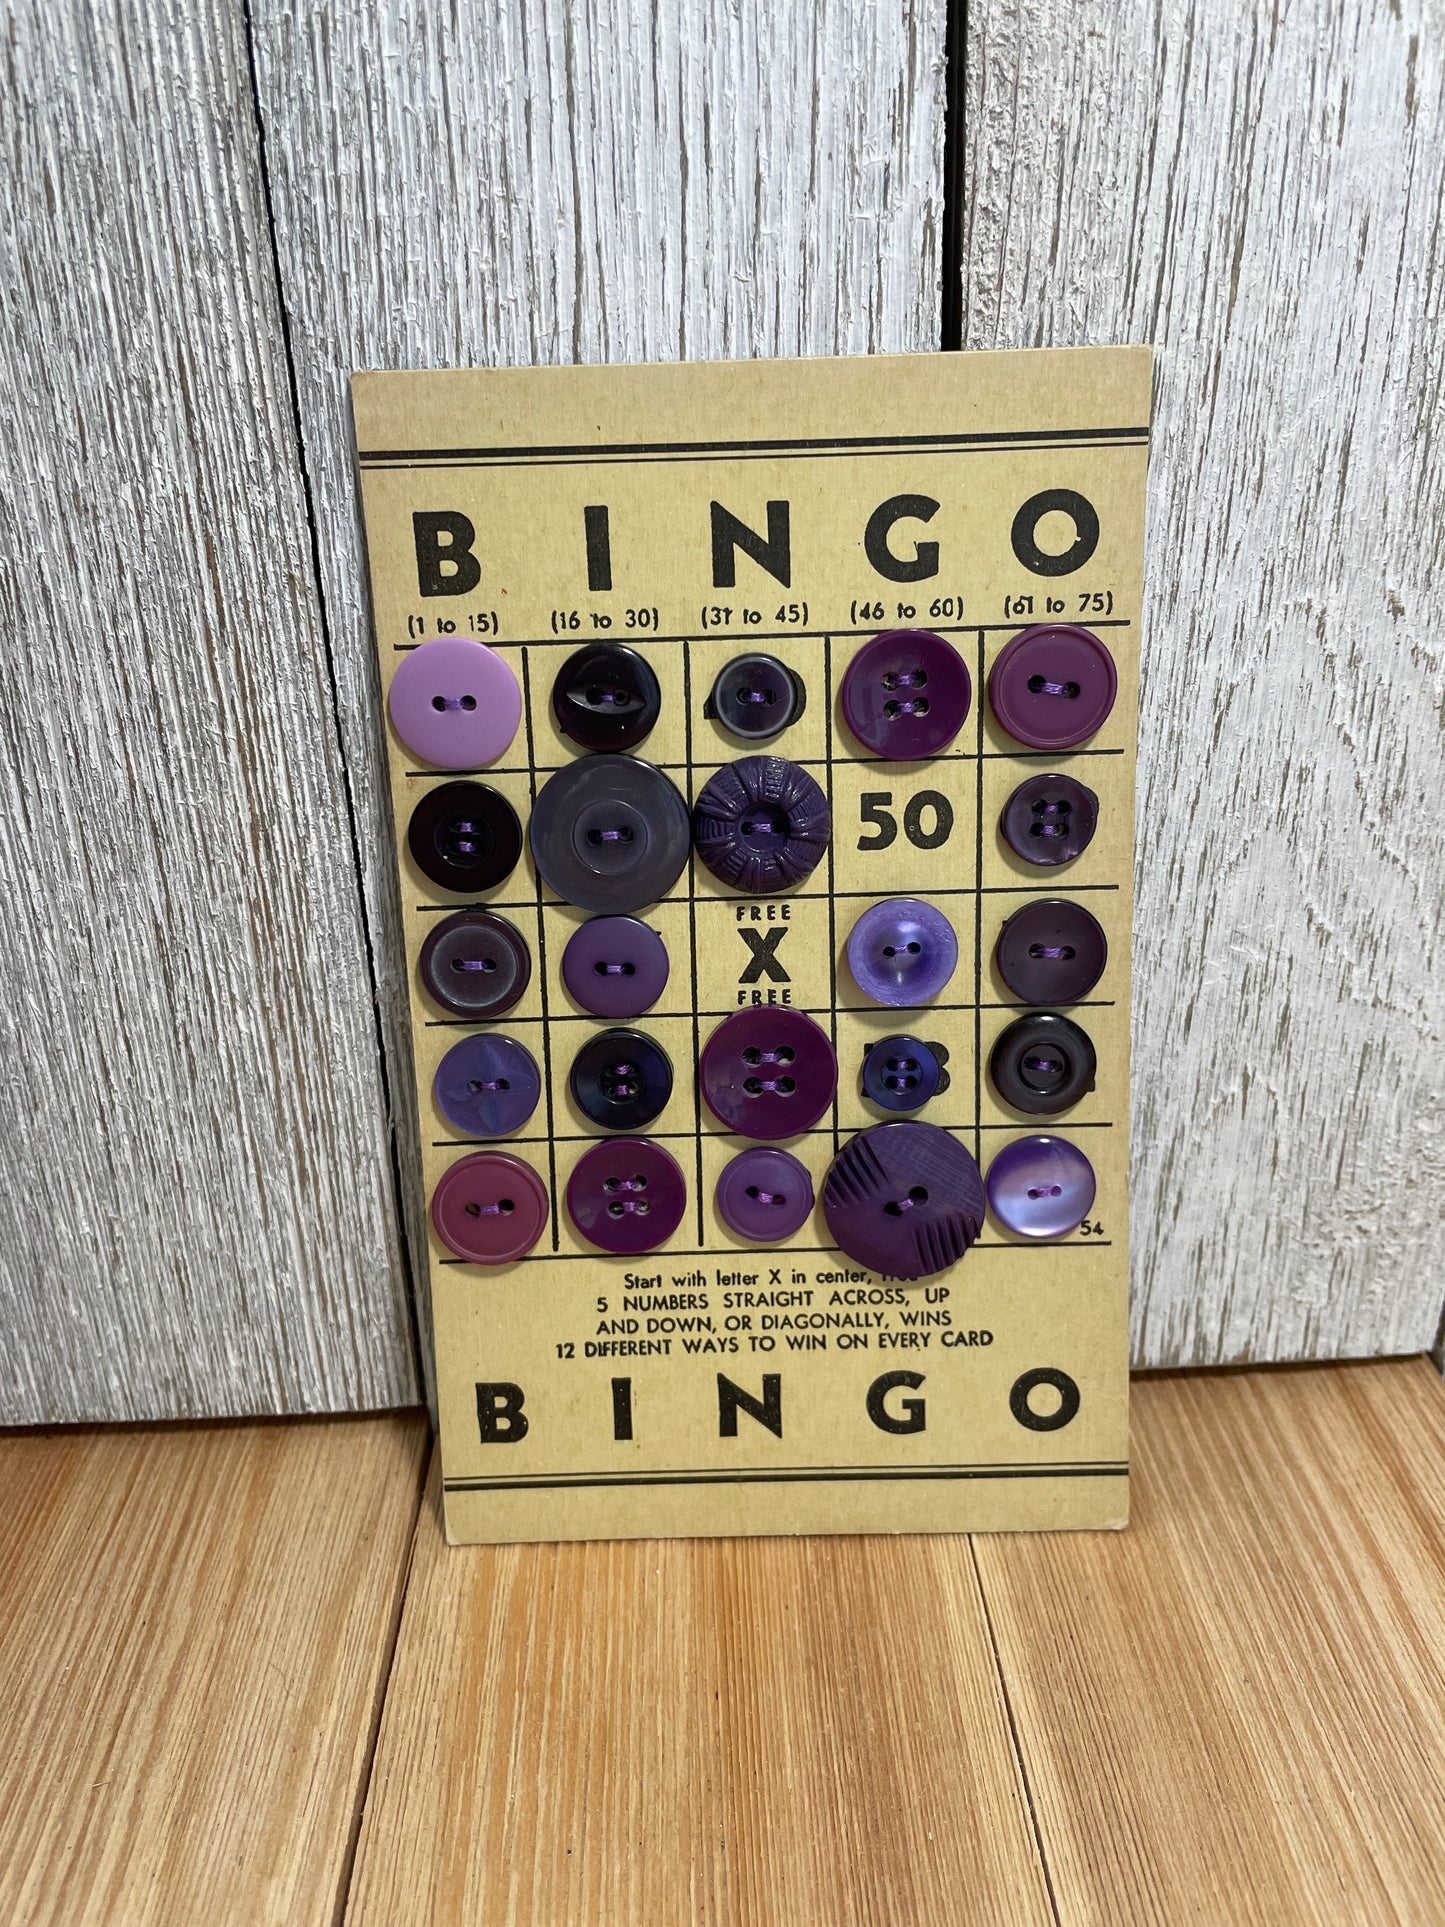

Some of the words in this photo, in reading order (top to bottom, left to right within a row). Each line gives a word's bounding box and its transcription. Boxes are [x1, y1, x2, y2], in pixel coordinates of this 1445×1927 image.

[702, 606, 733, 630] (31
[743, 609, 762, 624] to
[775, 602, 808, 626] 45)
[851, 601, 884, 625] (46
[897, 603, 916, 618] to
[930, 597, 963, 620] 60)
[1005, 596, 1033, 618] (61
[1047, 597, 1065, 613] to
[1079, 591, 1113, 615] 75)
[408, 615, 424, 639] (1
[437, 618, 456, 633] to
[469, 611, 498, 635] 15)
[552, 610, 580, 634] (16
[590, 613, 612, 628] to
[625, 608, 658, 631] 30)
[857, 790, 953, 850] 50
[734, 902, 790, 921] FREE
[737, 927, 791, 984] X
[738, 989, 791, 1005] FREE
[1080, 1219, 1104, 1236] 54
[624, 1273, 662, 1289] Start
[672, 1270, 706, 1287] with
[717, 1269, 759, 1286] letter
[769, 1269, 781, 1284] X
[792, 1269, 806, 1283] in
[816, 1268, 872, 1285] center,
[597, 1297, 608, 1312] 5
[624, 1294, 708, 1311] NUMBERS
[724, 1291, 813, 1308] STRAIGHT
[829, 1288, 909, 1306] ACROSS,
[925, 1288, 949, 1303] UP
[597, 1319, 639, 1335] AND
[647, 1317, 716, 1334] DOWN,
[725, 1315, 752, 1330] OR
[762, 1312, 889, 1330] DIAGONALLY,
[900, 1310, 951, 1326] WINS
[556, 1343, 574, 1358] 12
[585, 1339, 671, 1357] DIFFERENT
[682, 1337, 739, 1353] WAYS
[749, 1336, 775, 1352] TO
[786, 1335, 826, 1350] WIN
[837, 1334, 868, 1349] ON
[879, 1332, 930, 1351] EVERY
[941, 1330, 993, 1347] CARD
